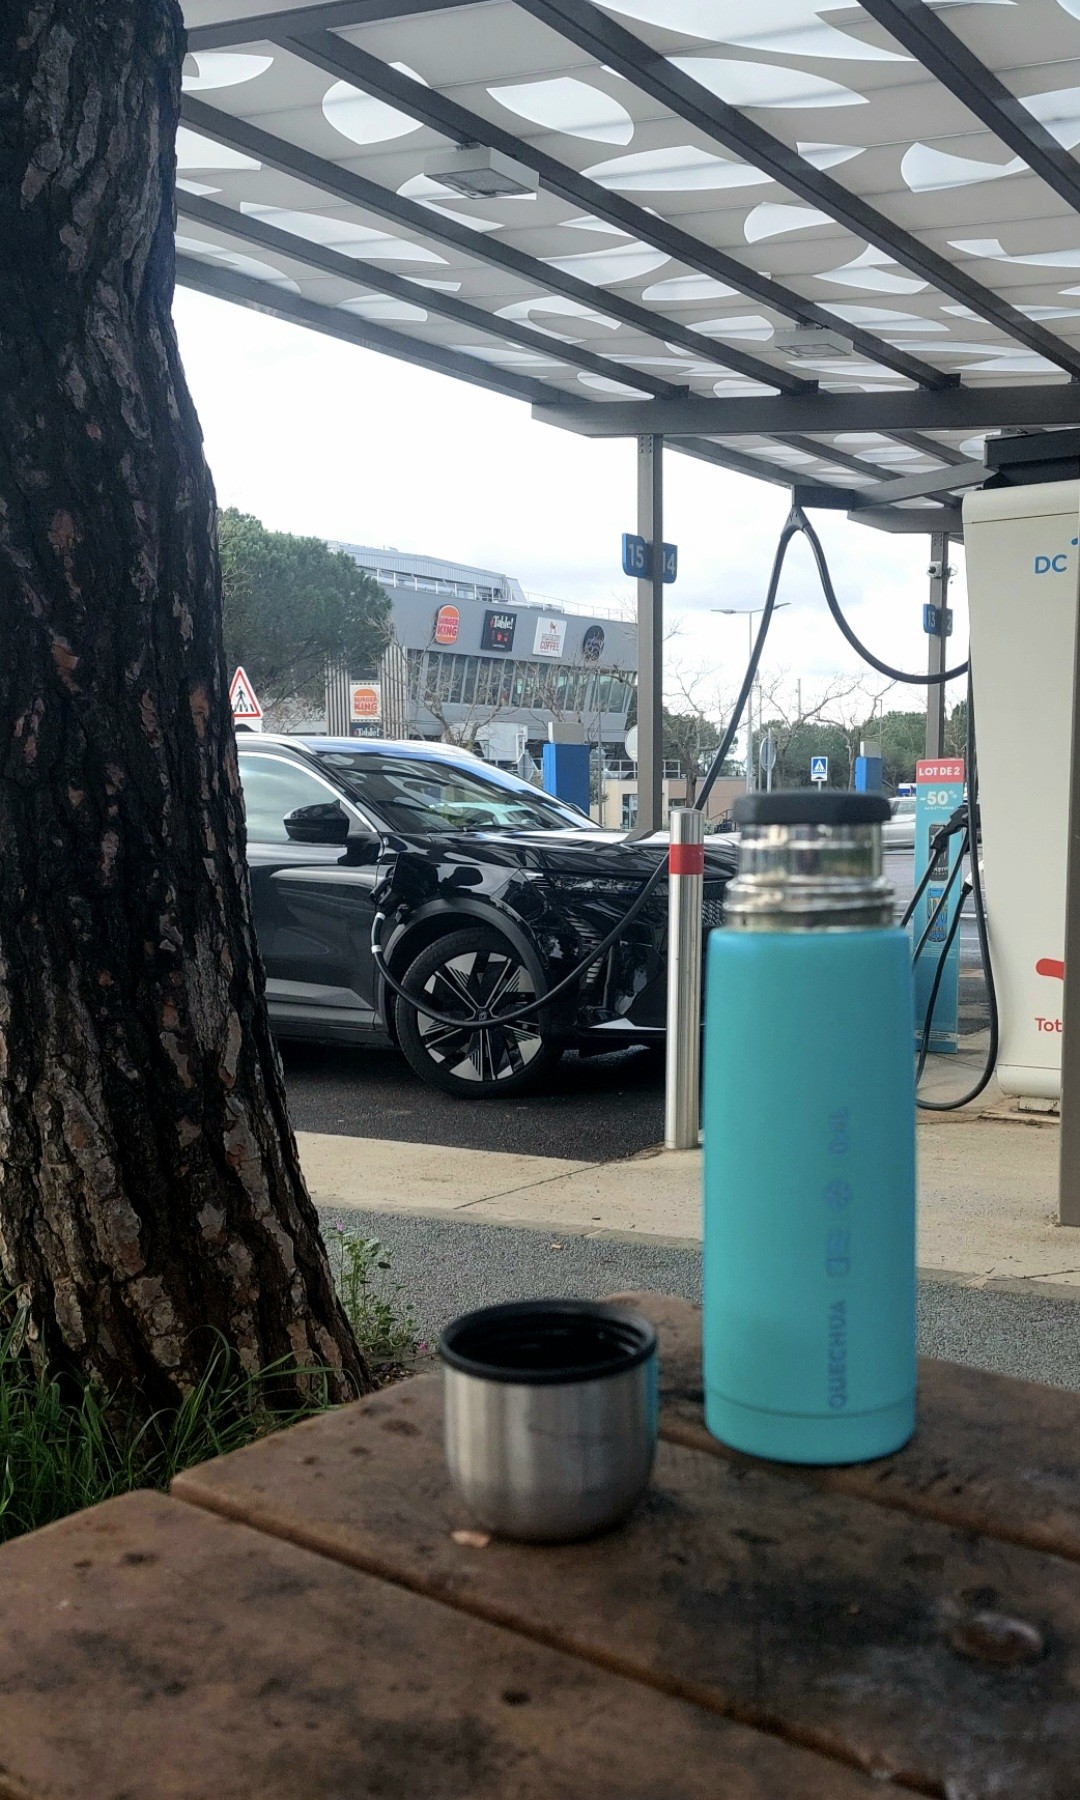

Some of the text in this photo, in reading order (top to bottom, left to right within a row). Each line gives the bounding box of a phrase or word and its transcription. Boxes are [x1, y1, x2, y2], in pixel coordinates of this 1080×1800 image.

[629, 543, 645, 569] 15
[662, 550, 676, 575] 14
[1034, 554, 1068, 574] DC
[927, 610, 936, 628] 13
[437, 624, 458, 637] KING
[354, 702, 378, 710] KING
[919, 766, 961, 776] LOT DE 2
[828, 1299, 848, 1410] QUECHUA
